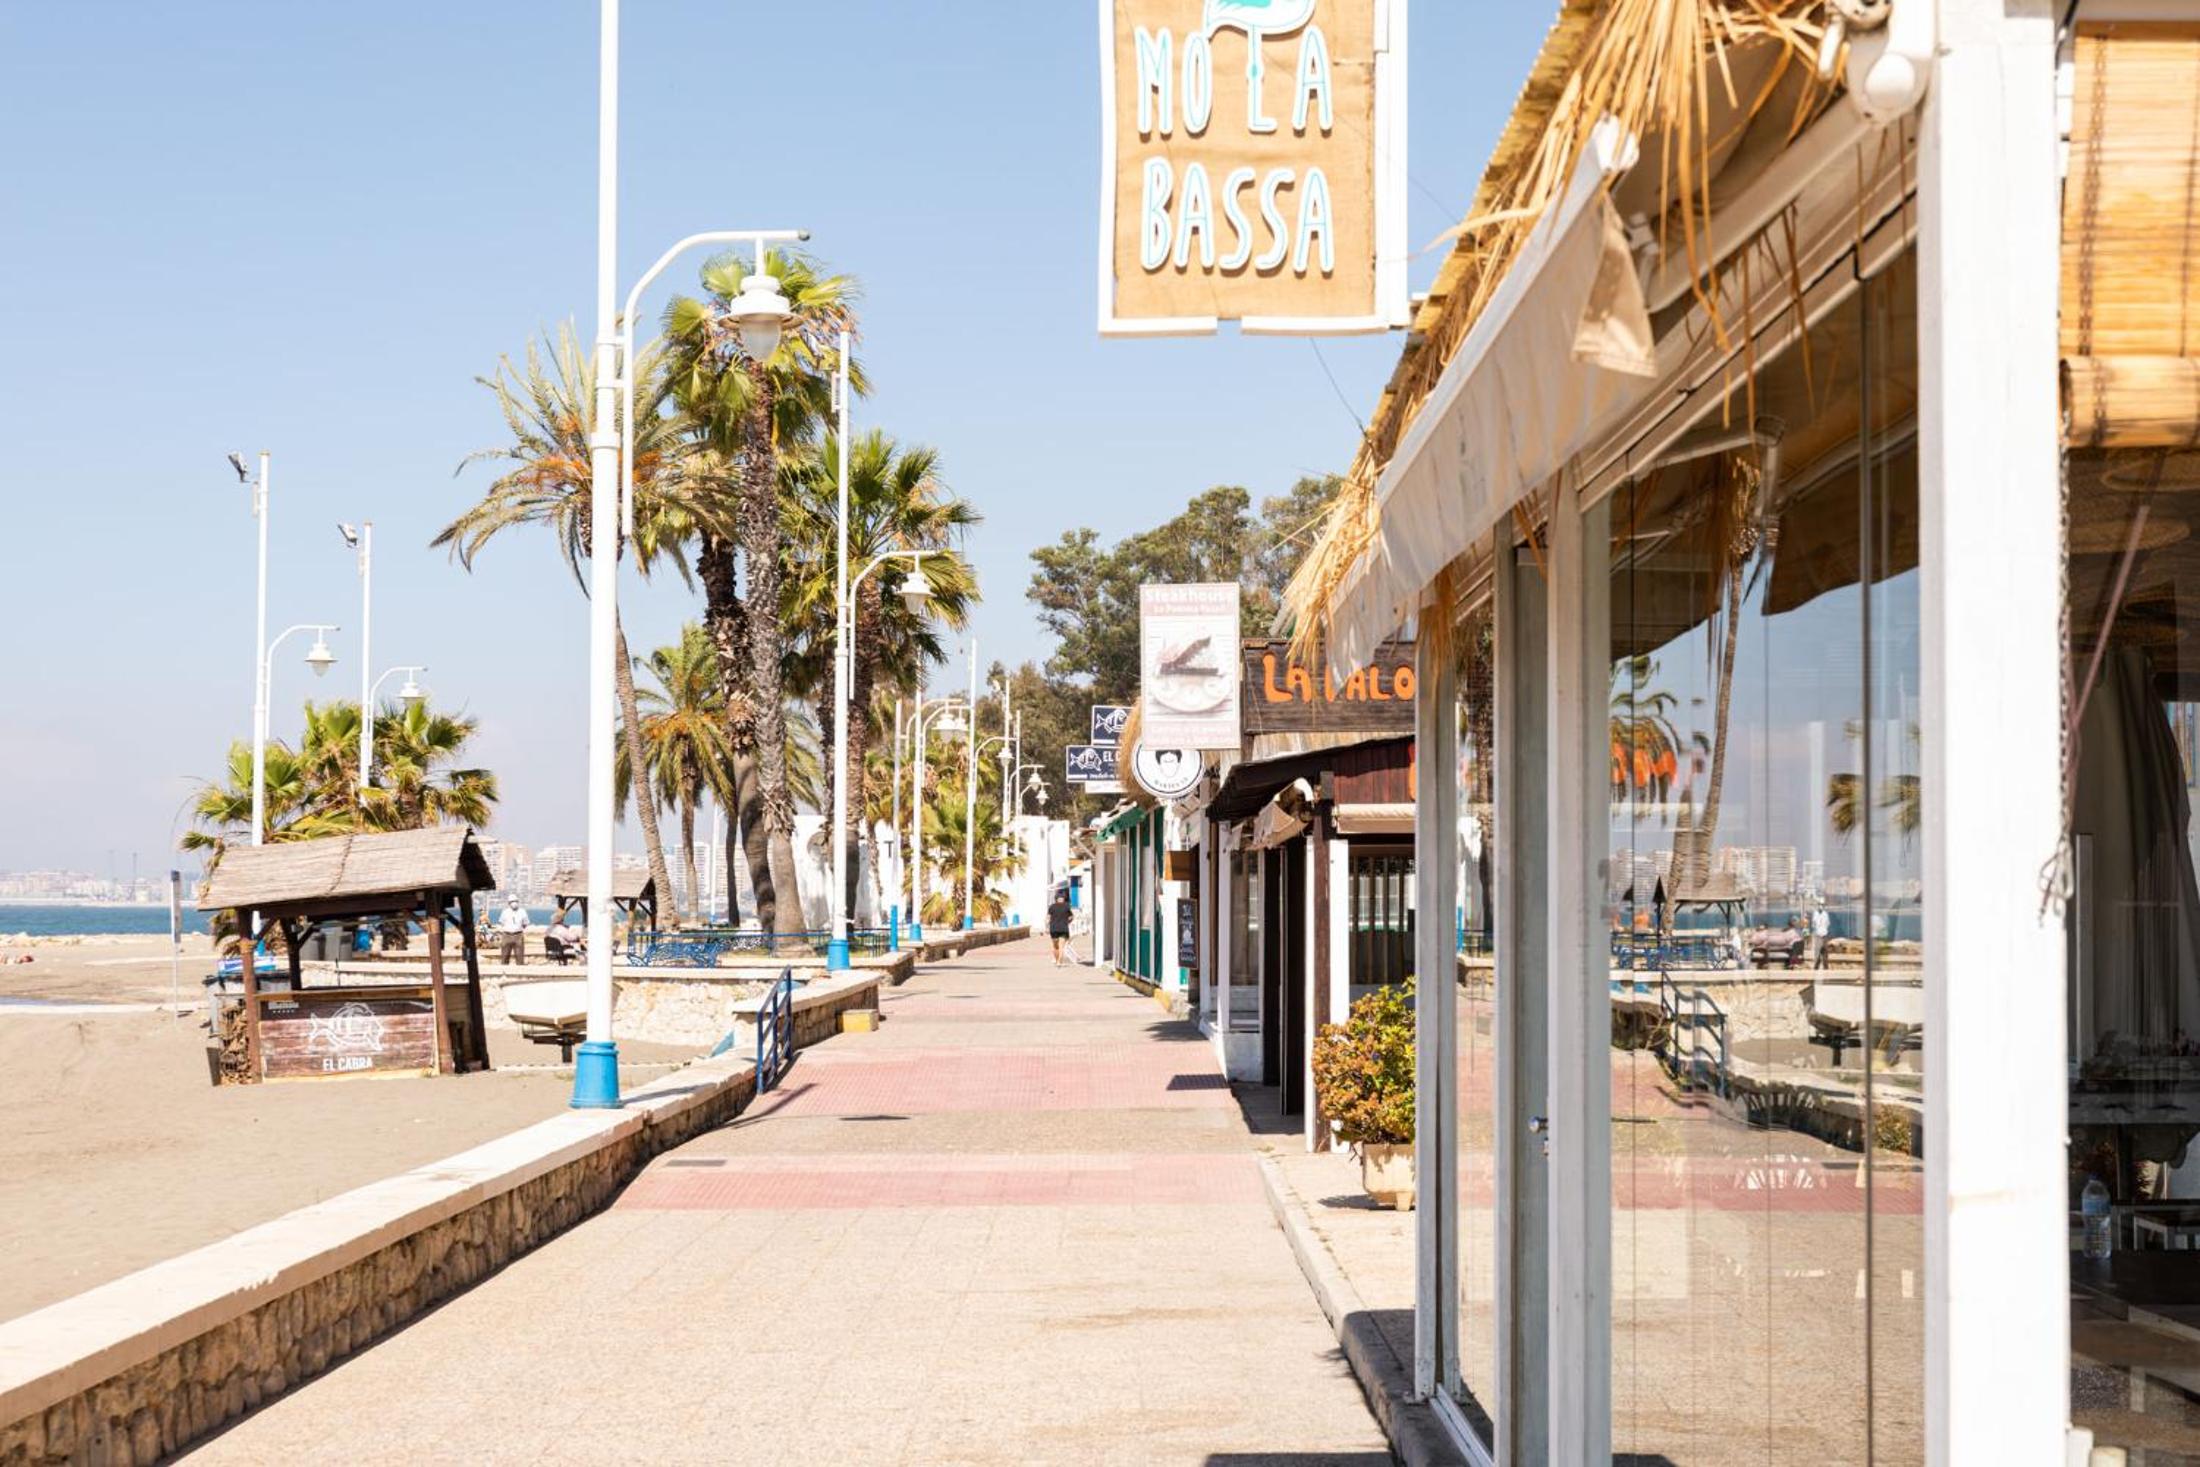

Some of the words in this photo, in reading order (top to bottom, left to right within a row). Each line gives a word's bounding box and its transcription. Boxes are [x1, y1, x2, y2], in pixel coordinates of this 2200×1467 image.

[1140, 156, 1335, 274] BASSA
[1263, 653, 1312, 703] LA
[1103, 751, 1114, 761] EL
[323, 1058, 334, 1071] EL
[338, 1056, 373, 1070] CABRA
